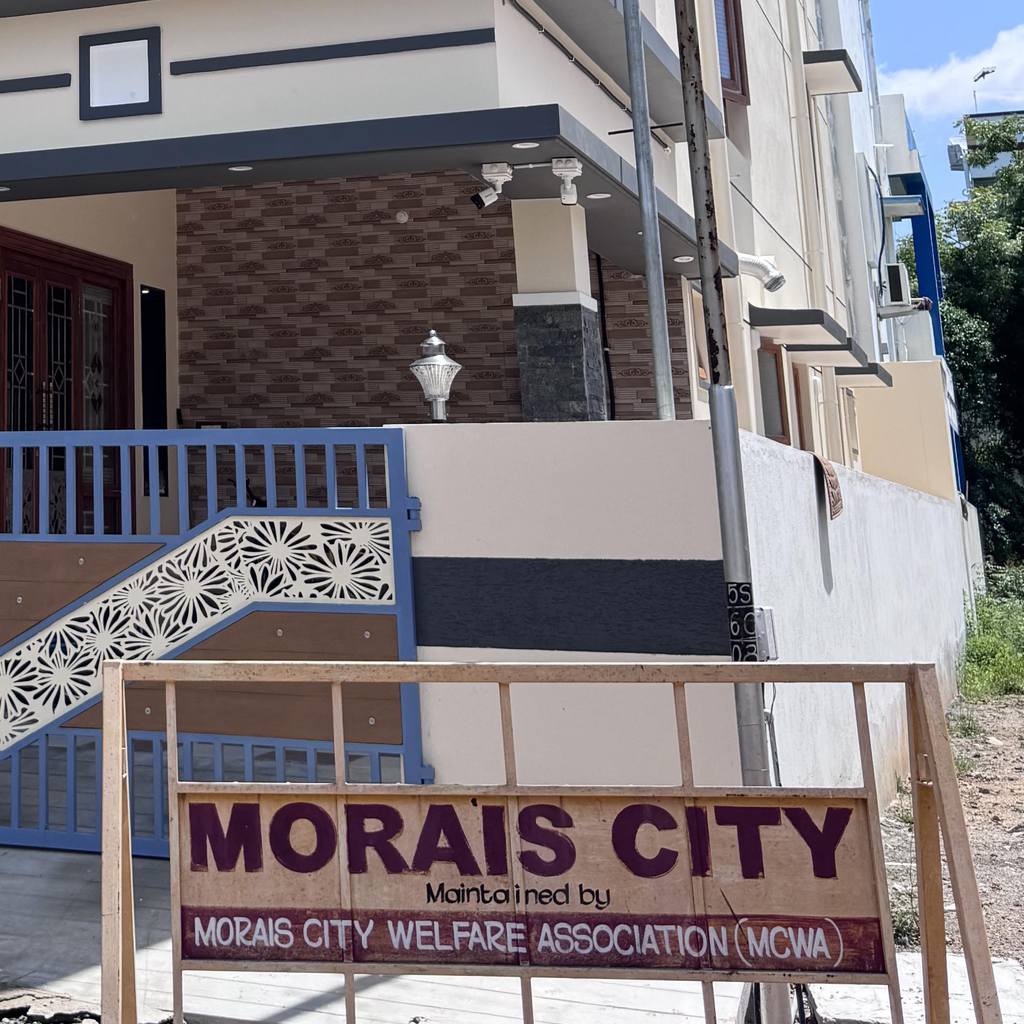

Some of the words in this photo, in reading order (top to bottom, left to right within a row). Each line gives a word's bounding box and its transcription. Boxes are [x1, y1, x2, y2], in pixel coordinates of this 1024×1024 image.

[188, 802, 576, 877] MORAIS
[611, 803, 853, 880] CITY
[426, 882, 570, 905] Maintained
[579, 883, 611, 910] by
[194, 916, 294, 949] MORAIS
[303, 918, 374, 950] CITY
[388, 919, 527, 953] WELFARE
[537, 922, 728, 958] ASSOCIATION
[734, 917, 844, 967] (MCWA)
